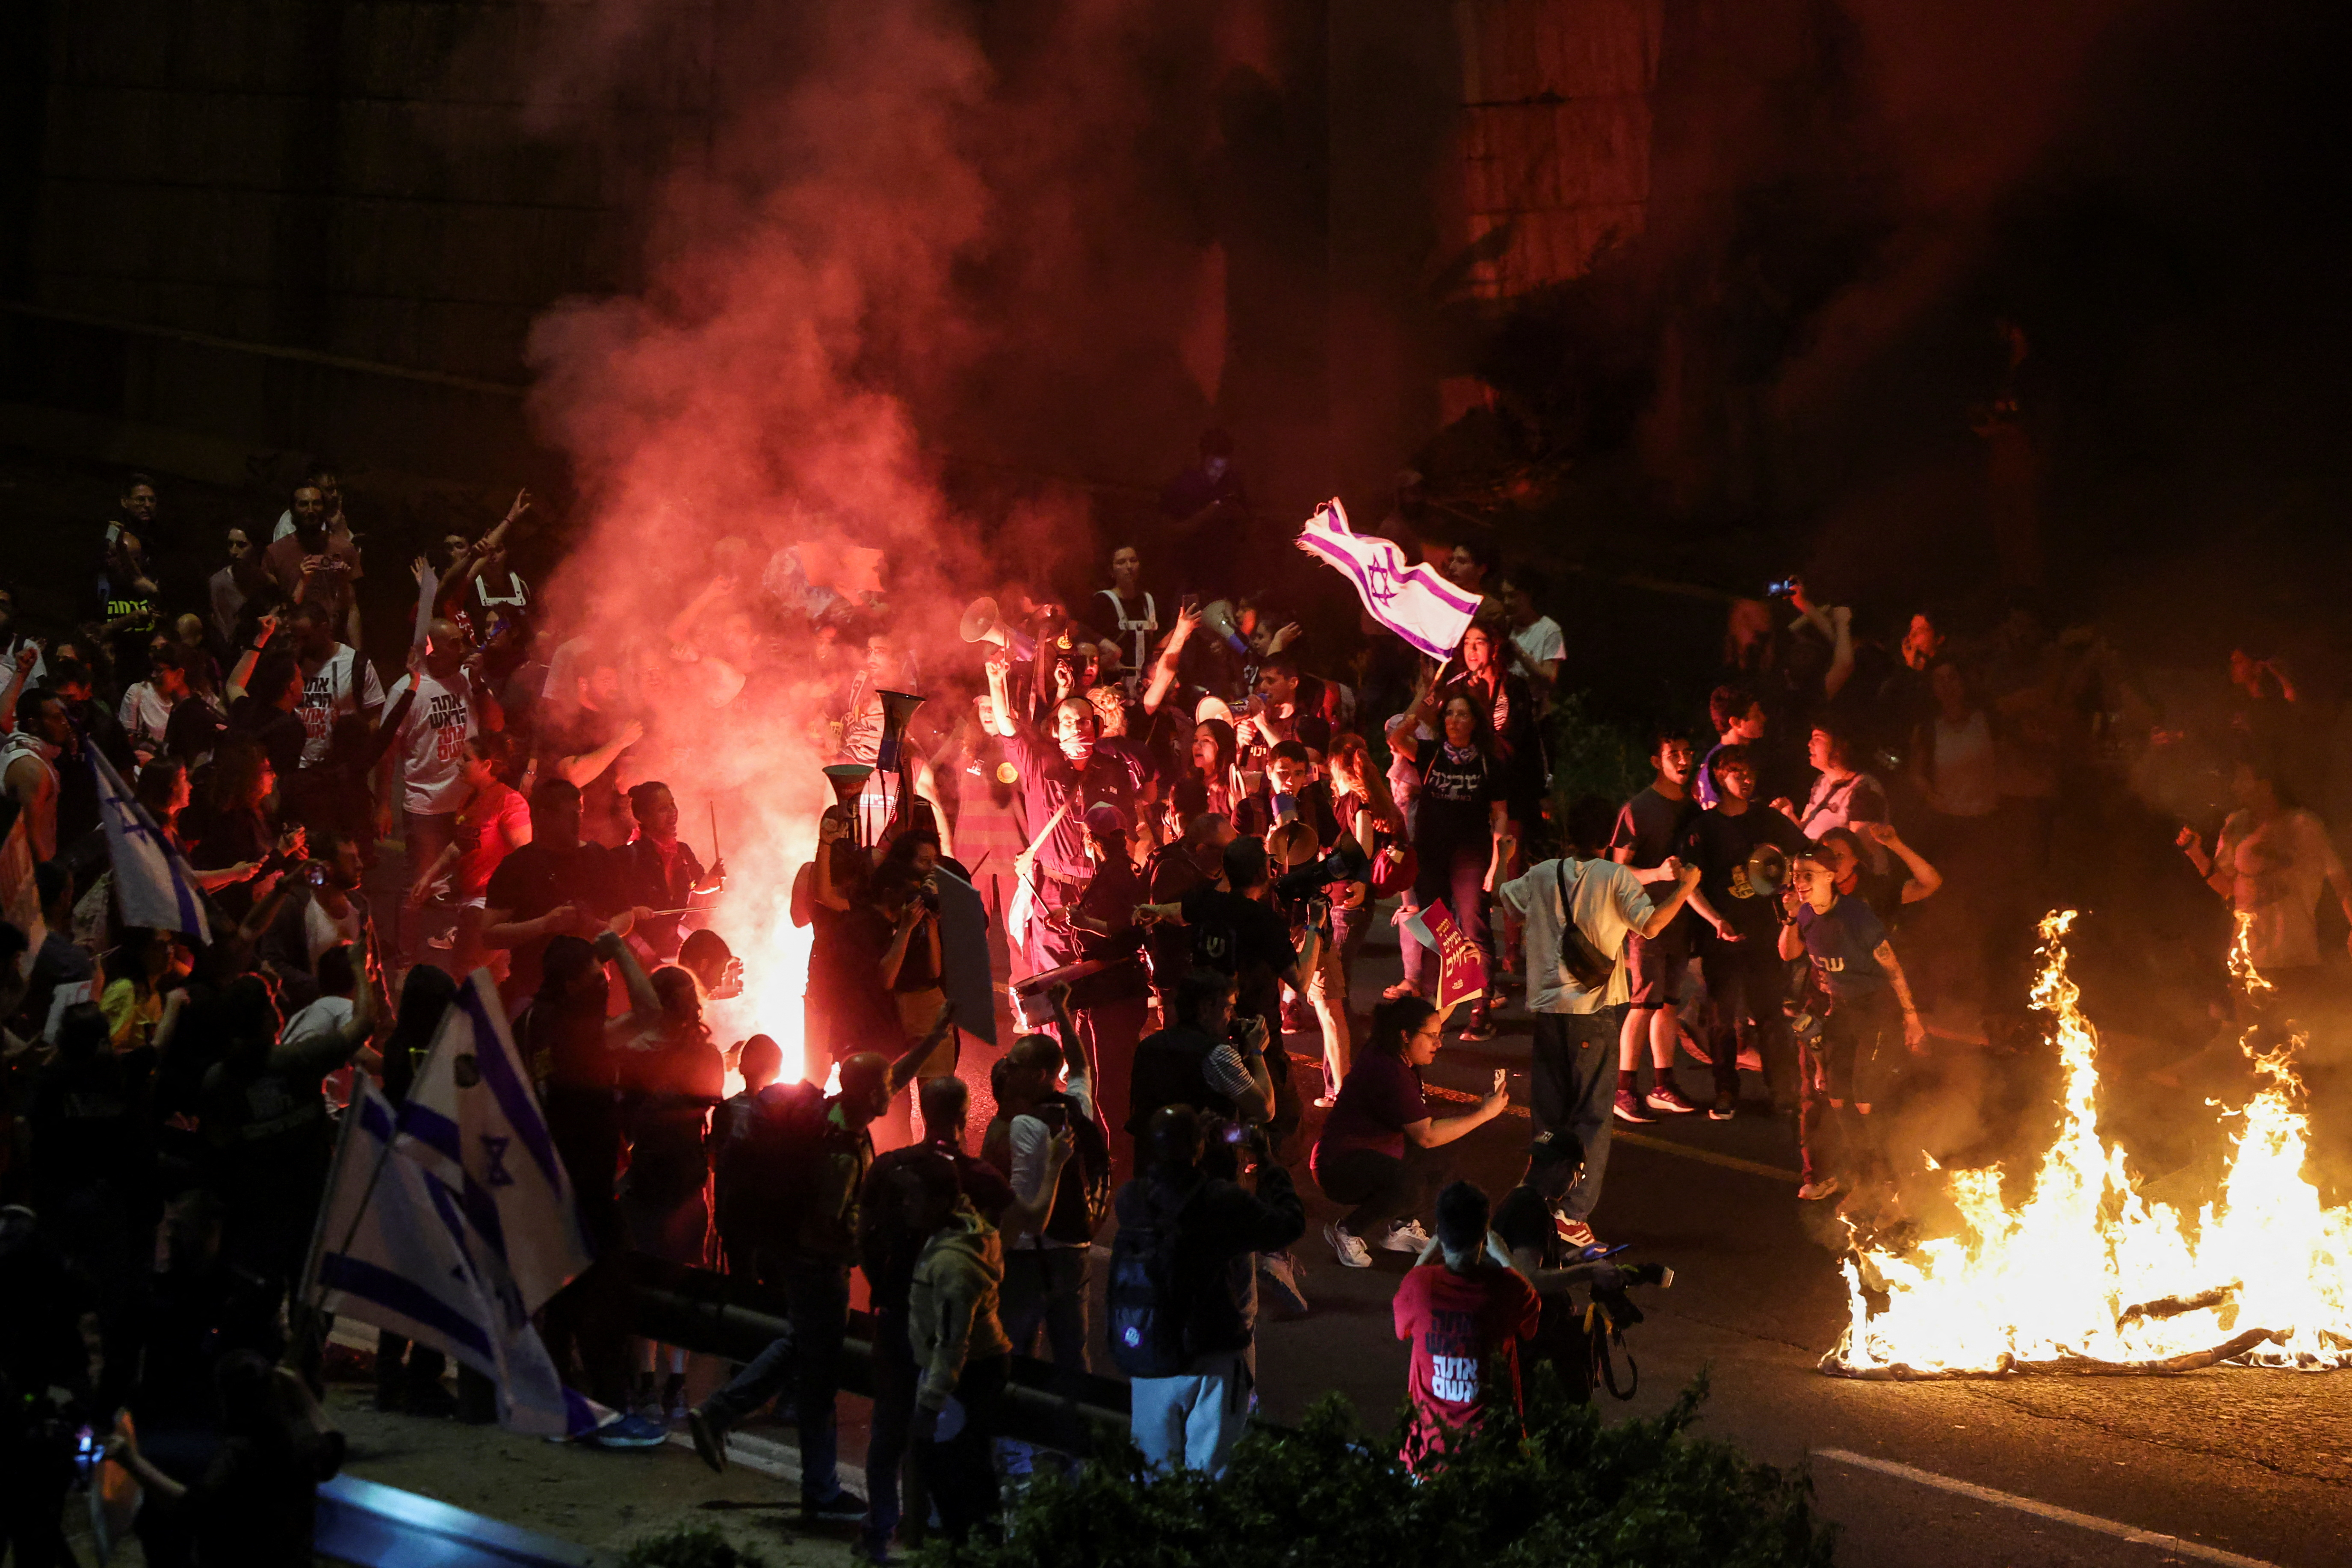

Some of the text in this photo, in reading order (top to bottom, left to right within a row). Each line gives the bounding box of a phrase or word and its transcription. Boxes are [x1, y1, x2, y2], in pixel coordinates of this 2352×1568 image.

[304, 693, 332, 708] הרא
[431, 694, 462, 712] אתה
[428, 708, 466, 729] הראש
[437, 725, 466, 744] אתה
[1446, 945, 1467, 978] חיים
[1426, 1332, 1473, 1356] ראש
[1433, 1355, 1478, 1380] אתה
[1432, 1376, 1480, 1403] אשם
